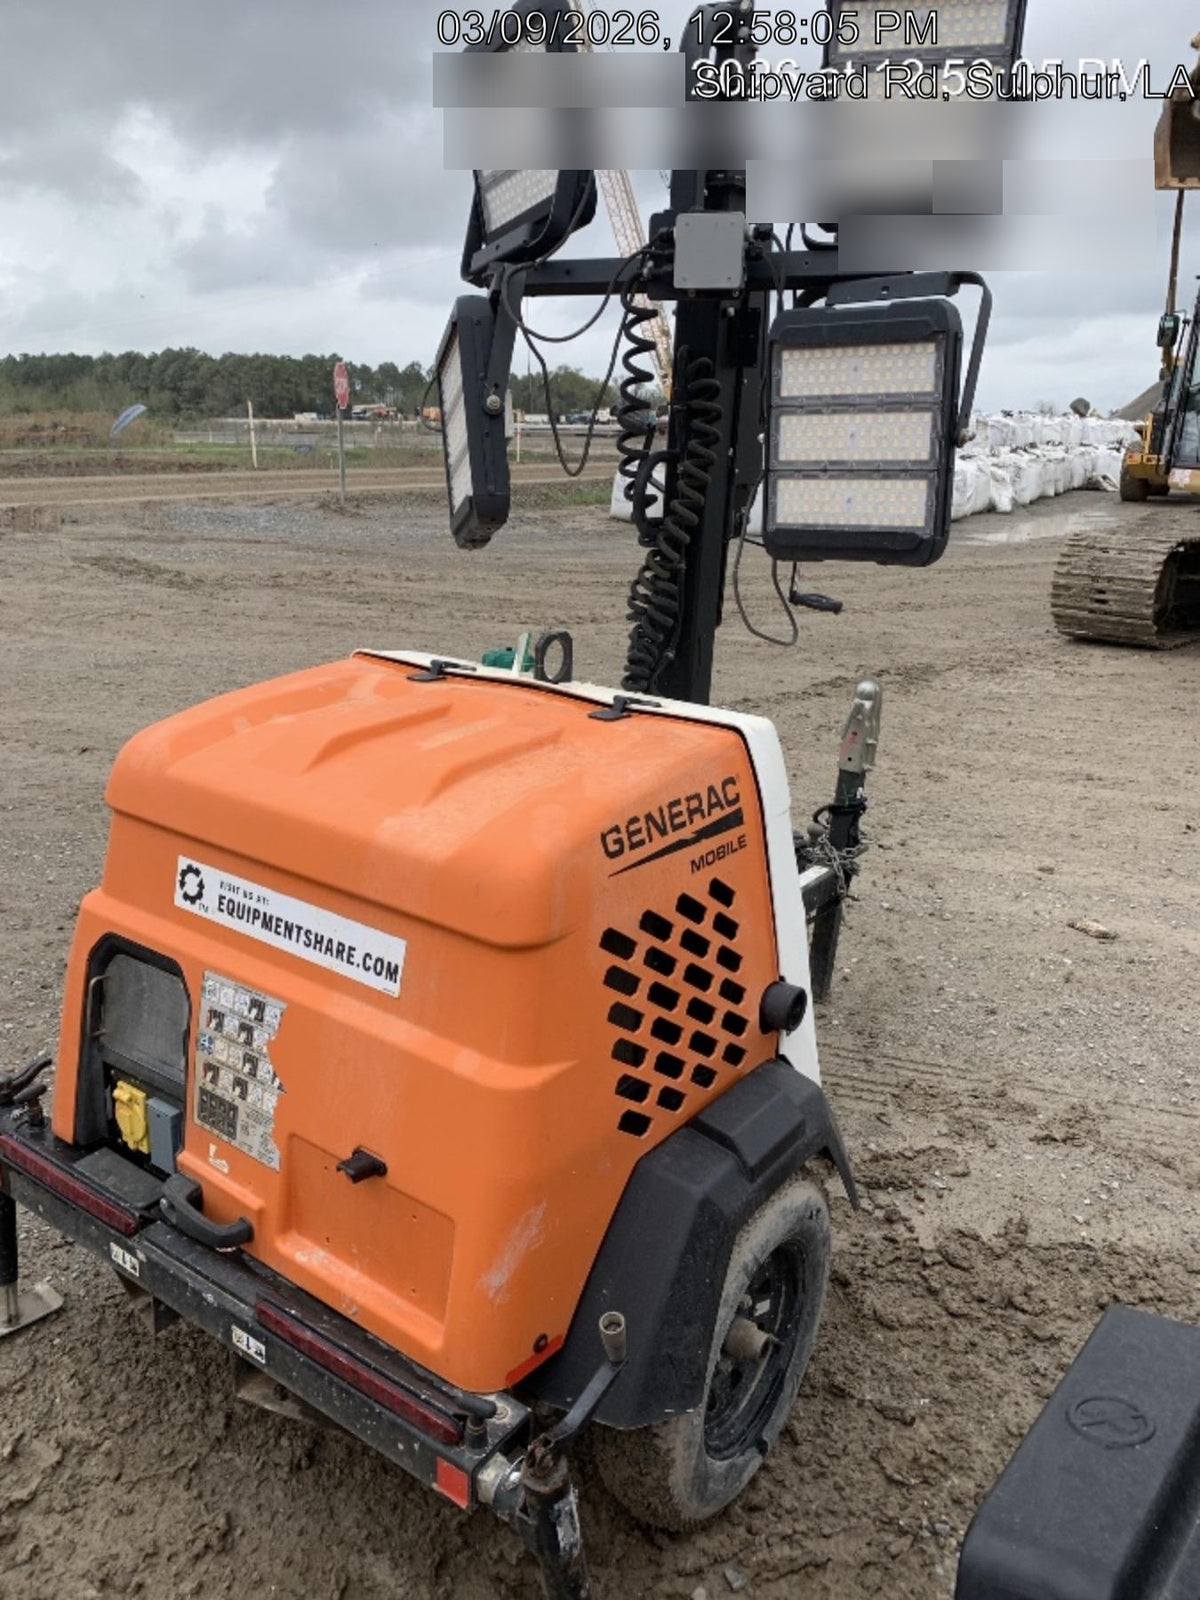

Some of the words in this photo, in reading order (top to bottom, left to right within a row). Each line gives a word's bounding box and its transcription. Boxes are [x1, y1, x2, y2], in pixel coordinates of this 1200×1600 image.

[600, 776, 741, 860] GENERAC
[689, 834, 748, 874] MOBILE
[217, 893, 399, 984] EQUIPMENTSHARE.COM
